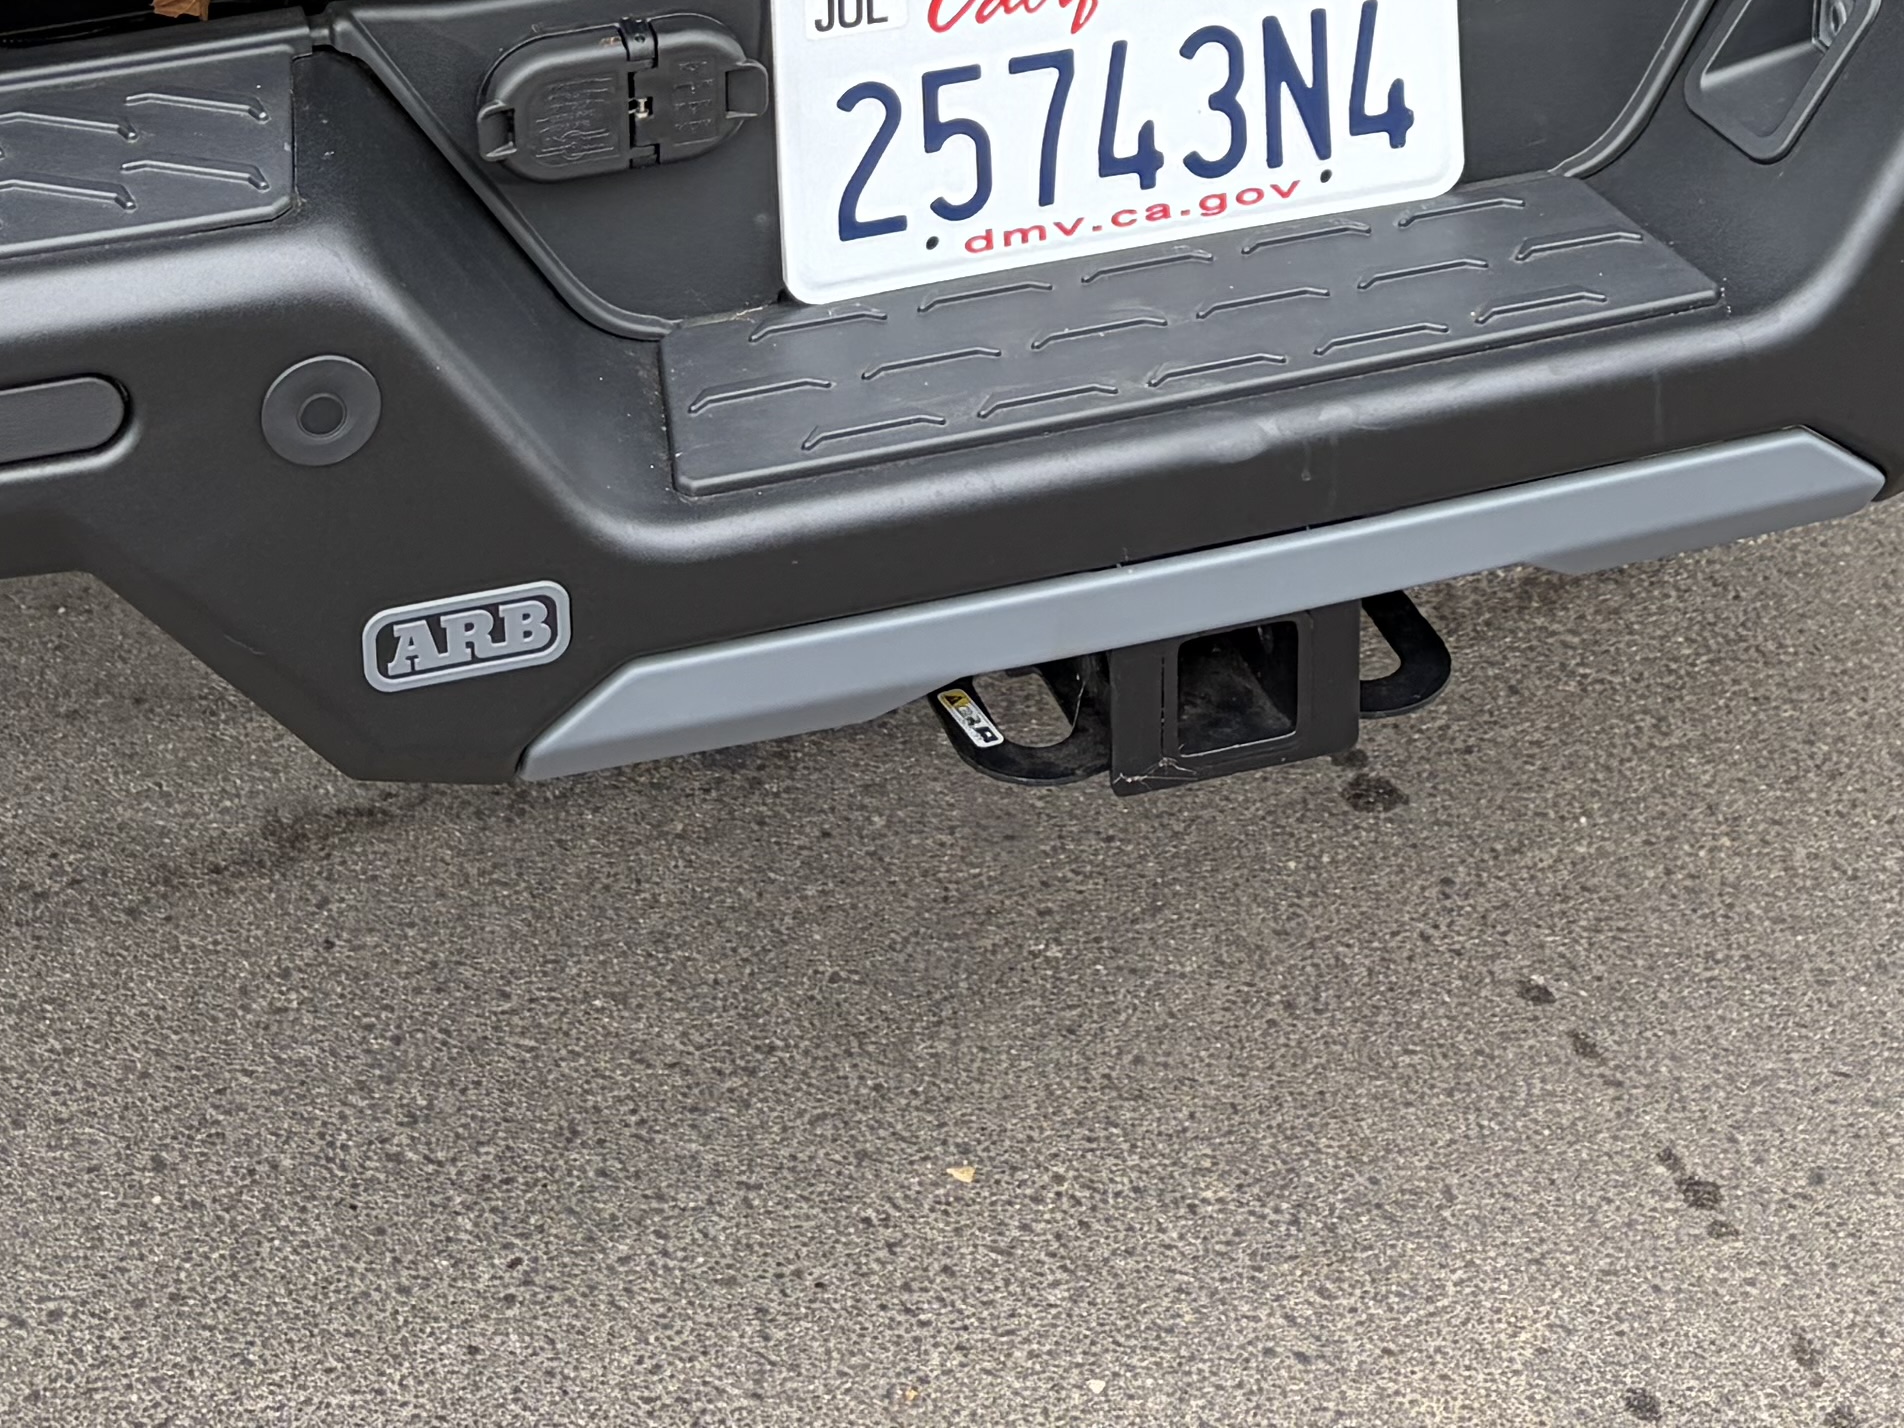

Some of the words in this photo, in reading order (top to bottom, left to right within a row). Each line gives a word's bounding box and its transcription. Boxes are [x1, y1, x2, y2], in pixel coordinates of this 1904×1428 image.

[836, 0, 1416, 243] 25743N4
[963, 180, 1302, 254] dmv.ca.gov
[387, 599, 552, 677] ARB
